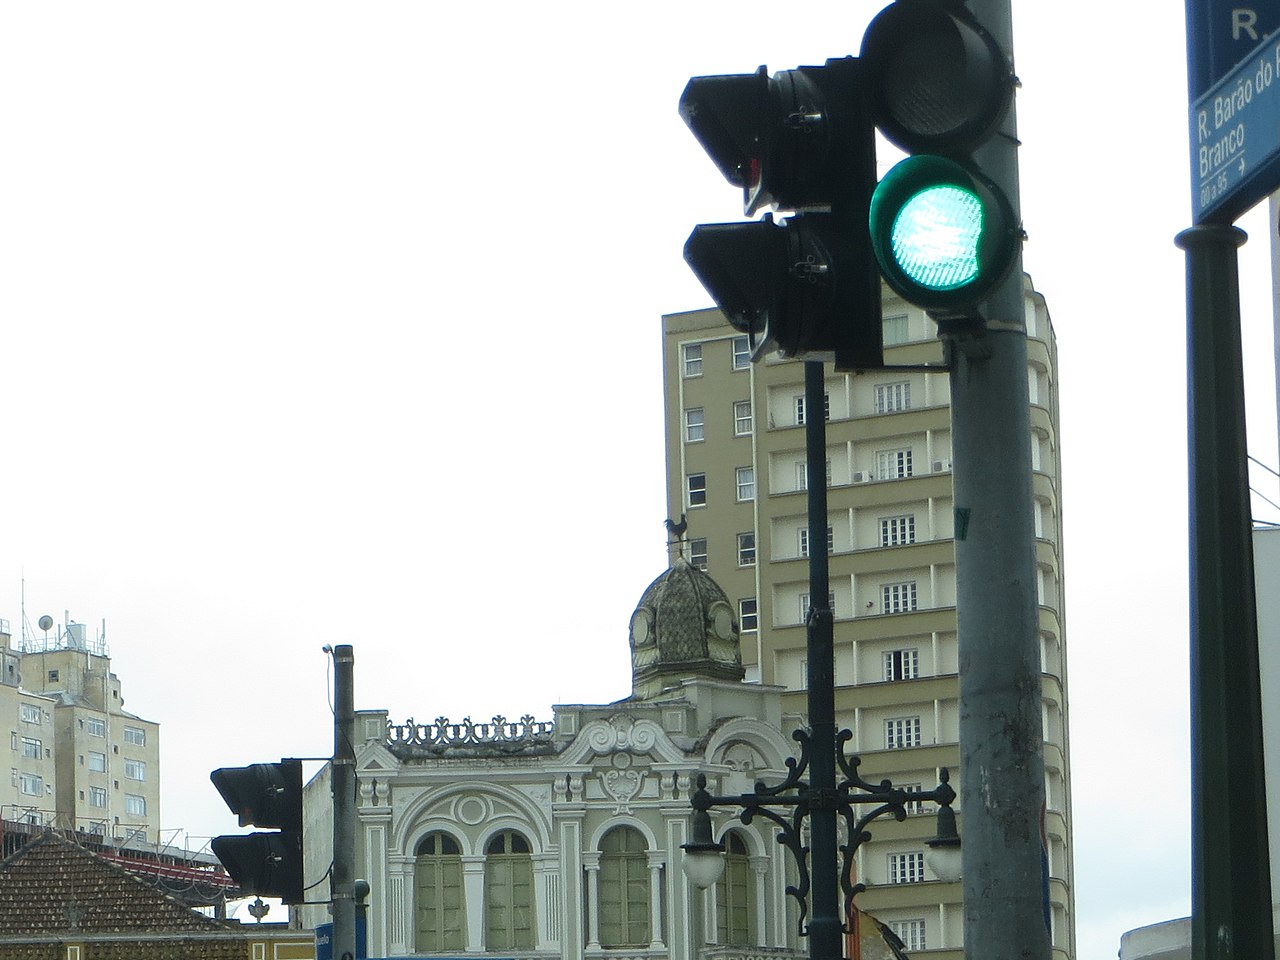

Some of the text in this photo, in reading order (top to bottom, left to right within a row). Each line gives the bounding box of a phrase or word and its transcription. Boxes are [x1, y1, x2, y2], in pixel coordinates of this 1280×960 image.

[1198, 110, 1211, 144] R.
[1215, 78, 1252, 130] Barão
[1256, 59, 1271, 94] do
[1199, 124, 1244, 178] Branco
